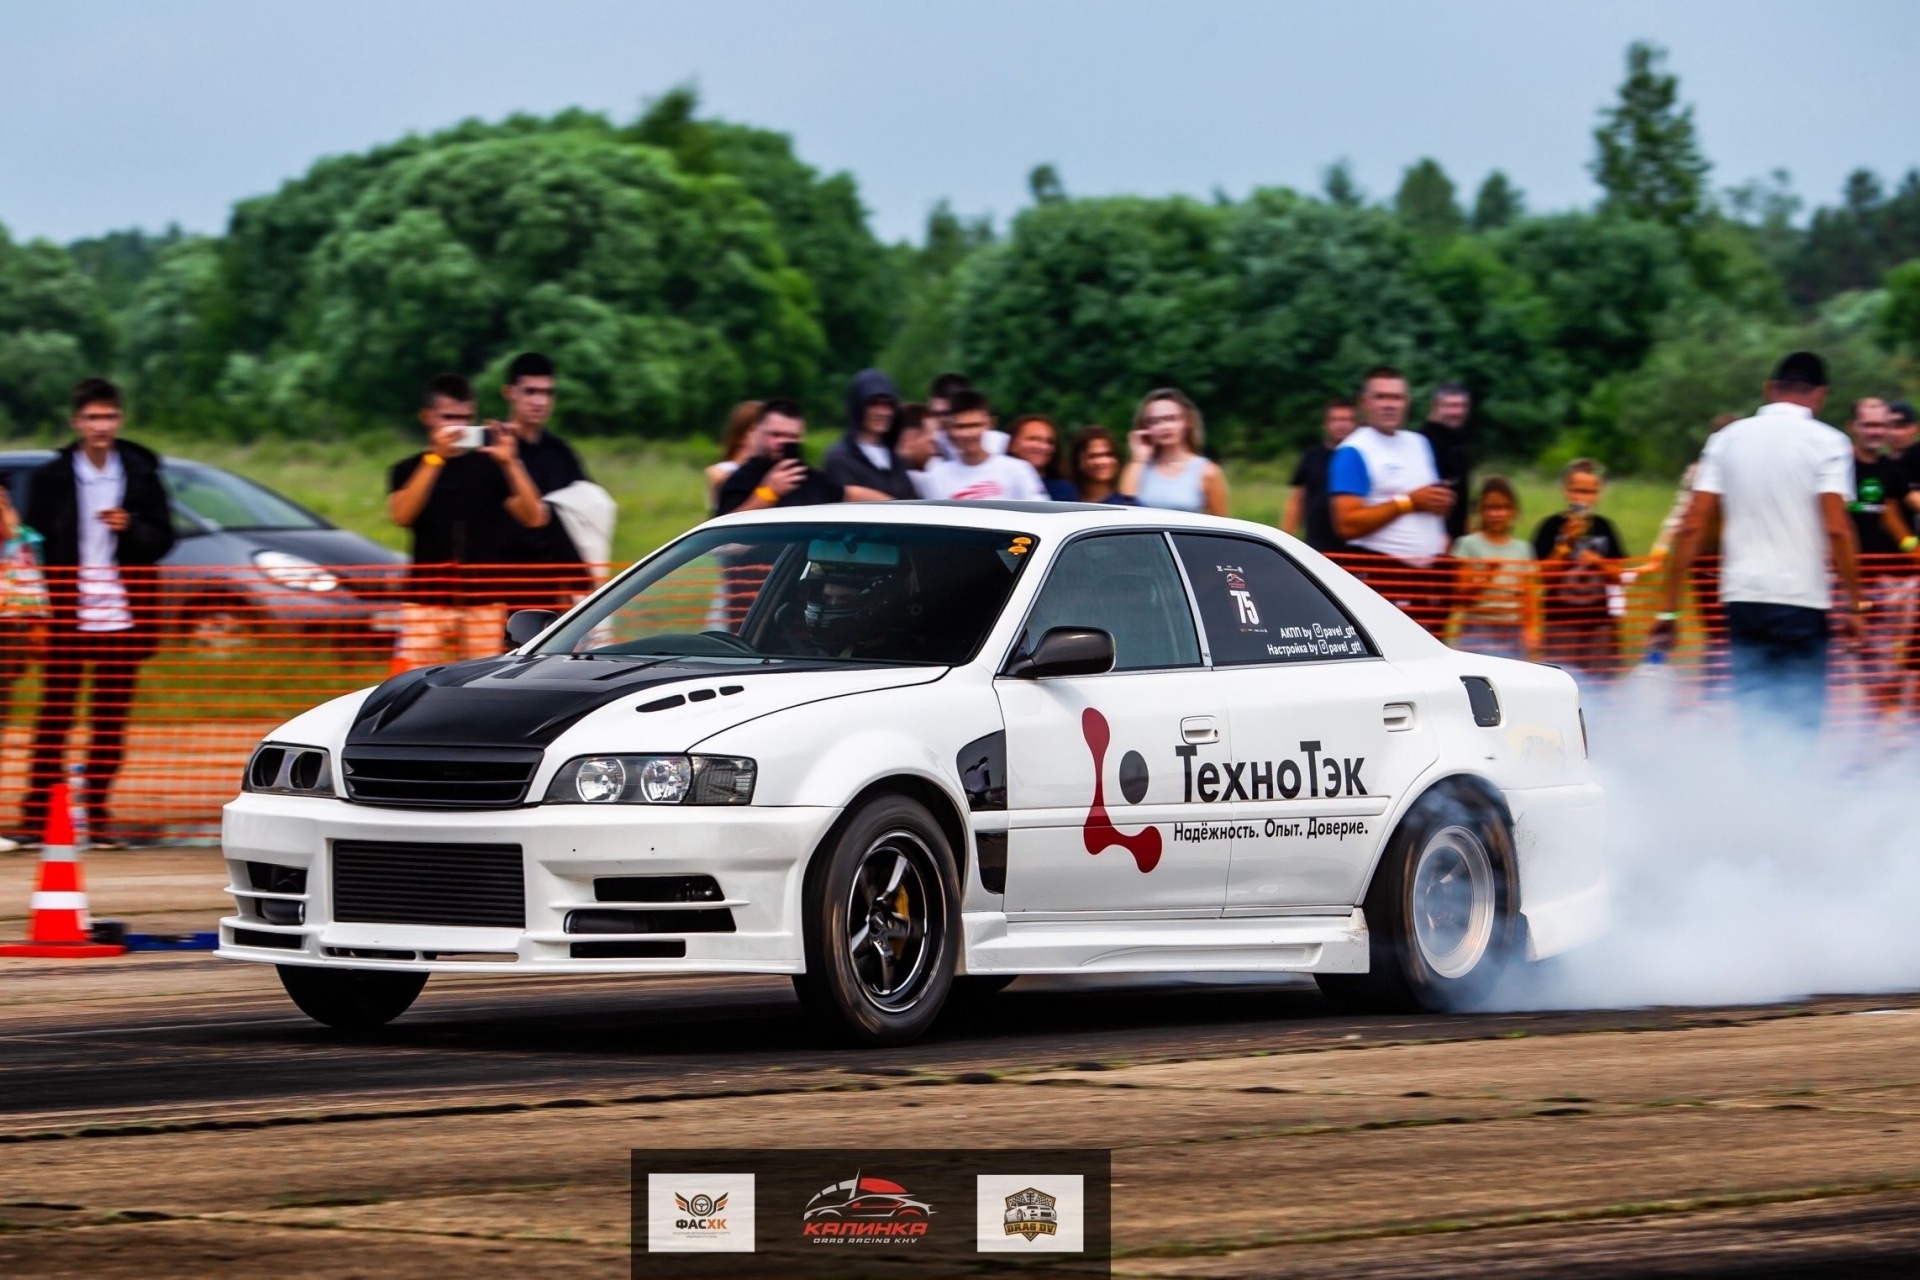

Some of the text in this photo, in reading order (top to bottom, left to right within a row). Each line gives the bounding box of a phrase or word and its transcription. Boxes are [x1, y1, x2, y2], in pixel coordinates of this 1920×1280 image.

[1230, 590, 1260, 625] 75
[1280, 626, 1302, 639] АКПП
[1301, 627, 1312, 640] by
[1267, 642, 1308, 657] Настройка
[1307, 641, 1318, 656] by
[1175, 740, 1368, 803] ТехноТэк
[1174, 817, 1369, 843] Надёжность. Опыт. Доверие.
